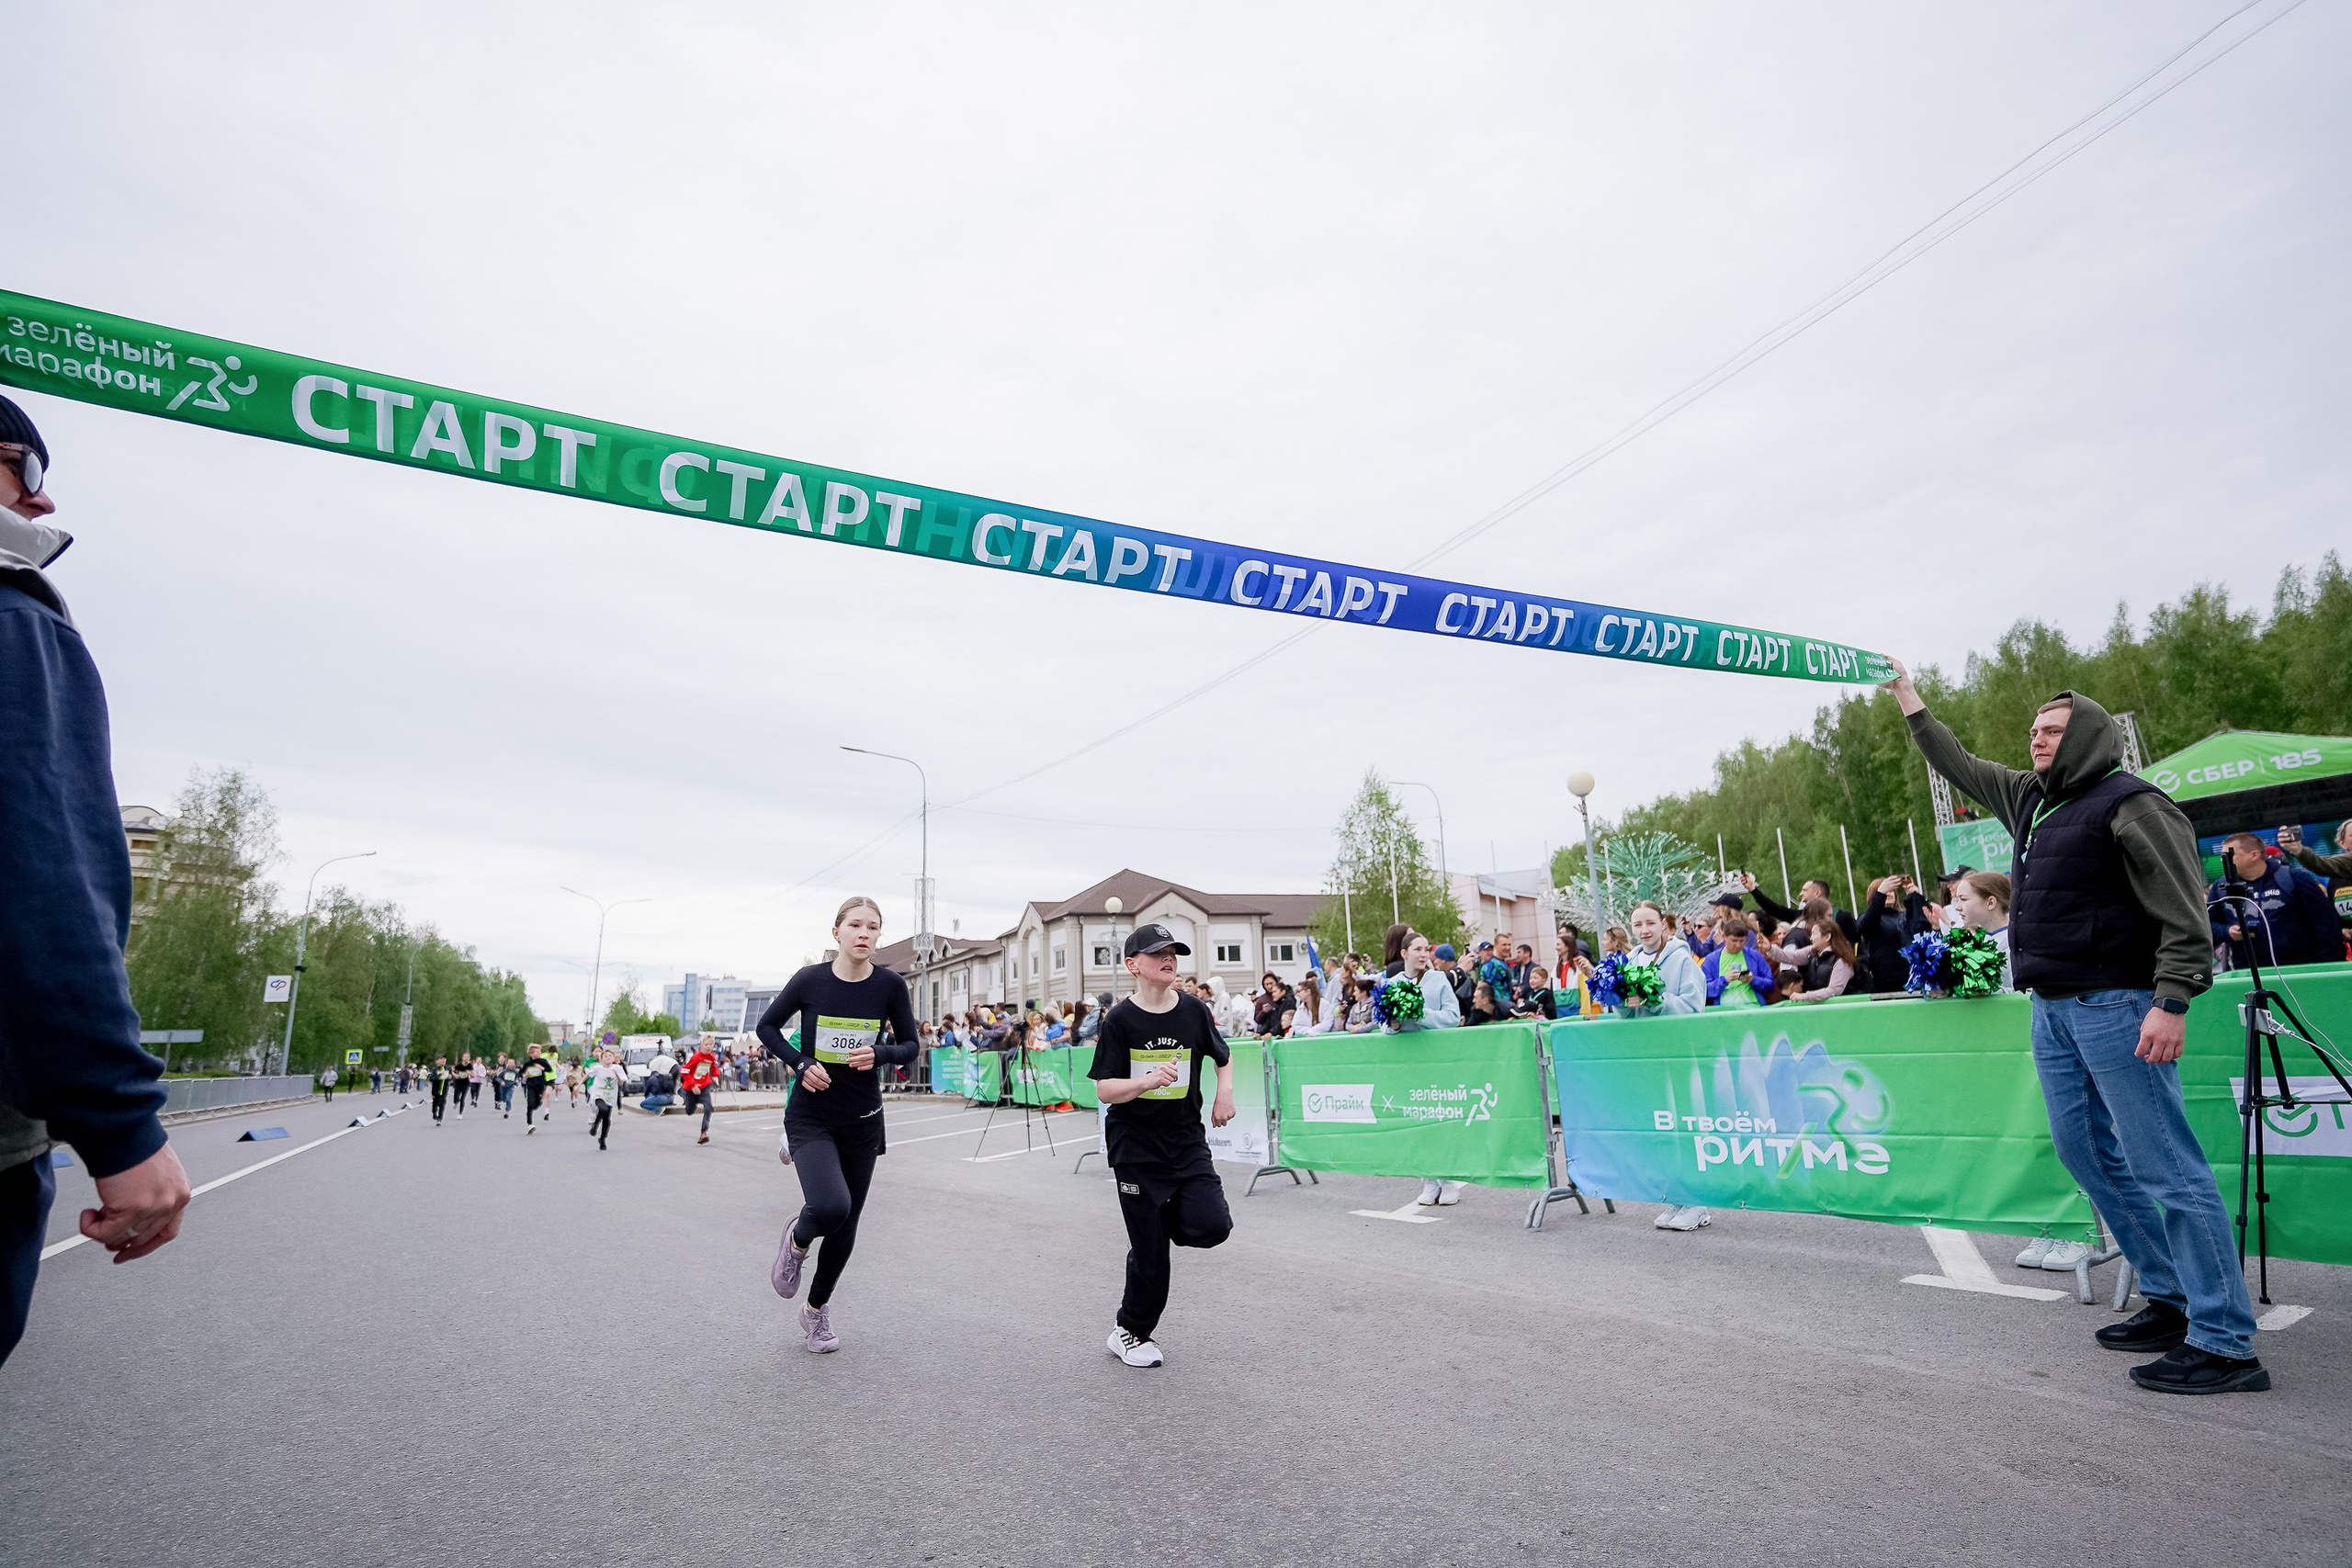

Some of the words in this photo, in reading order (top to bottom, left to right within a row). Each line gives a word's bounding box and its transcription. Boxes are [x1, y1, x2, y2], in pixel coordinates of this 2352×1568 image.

[7, 316, 175, 370] зелёный
[291, 375, 597, 489] СТАРТ
[659, 451, 922, 547] СТАРТ
[971, 513, 1193, 592] СТАРТ
[1230, 558, 1408, 624] СТАРТ
[1435, 592, 1574, 646] СТАРТ
[1594, 614, 1700, 660] СТАРТ
[1716, 629, 1792, 671] СТАРТ
[1804, 642, 1860, 680] СТАРТ
[2187, 759, 2255, 784] СБЕР
[2270, 749, 2322, 771] 185
[831, 1037, 863, 1050] 3086
[1158, 1036, 1178, 1047] JUST
[1409, 1084, 1468, 1101] зелёный
[1325, 1095, 1364, 1113] Прайм
[1402, 1105, 1464, 1122] марафон
[1654, 1111, 1675, 1131] В
[1681, 1111, 1777, 1134] твоём
[1693, 1134, 1891, 1175] ритме
